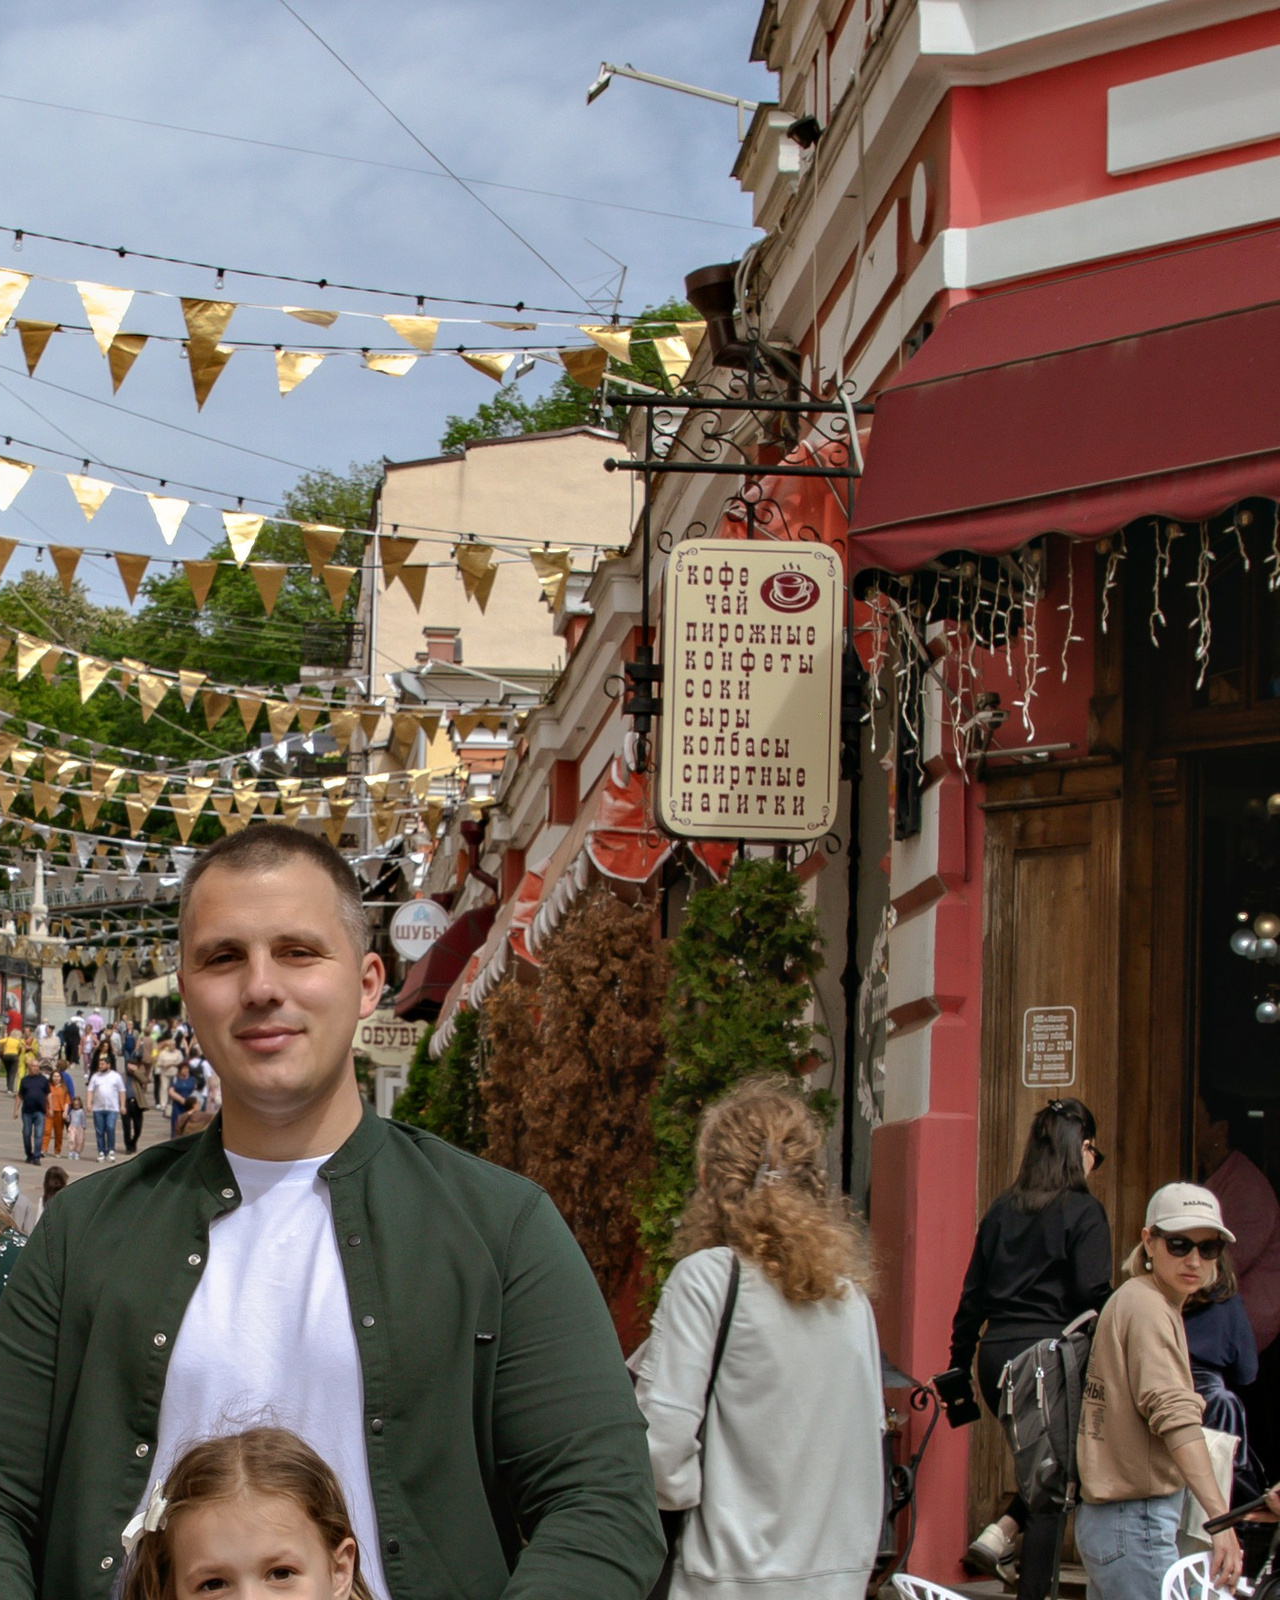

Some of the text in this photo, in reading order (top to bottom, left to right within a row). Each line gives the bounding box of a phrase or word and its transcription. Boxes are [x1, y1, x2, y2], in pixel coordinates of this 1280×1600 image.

[687, 561, 749, 592] кофе
[705, 590, 749, 616] чай
[685, 621, 816, 648] пирожные
[685, 648, 814, 677] конфеты
[685, 679, 751, 701] соки
[684, 707, 751, 733] сыры
[682, 731, 790, 758] колбасы
[682, 763, 806, 791] спиртные
[681, 792, 805, 816] напитки
[361, 1026, 420, 1046] ОБУВЬ
